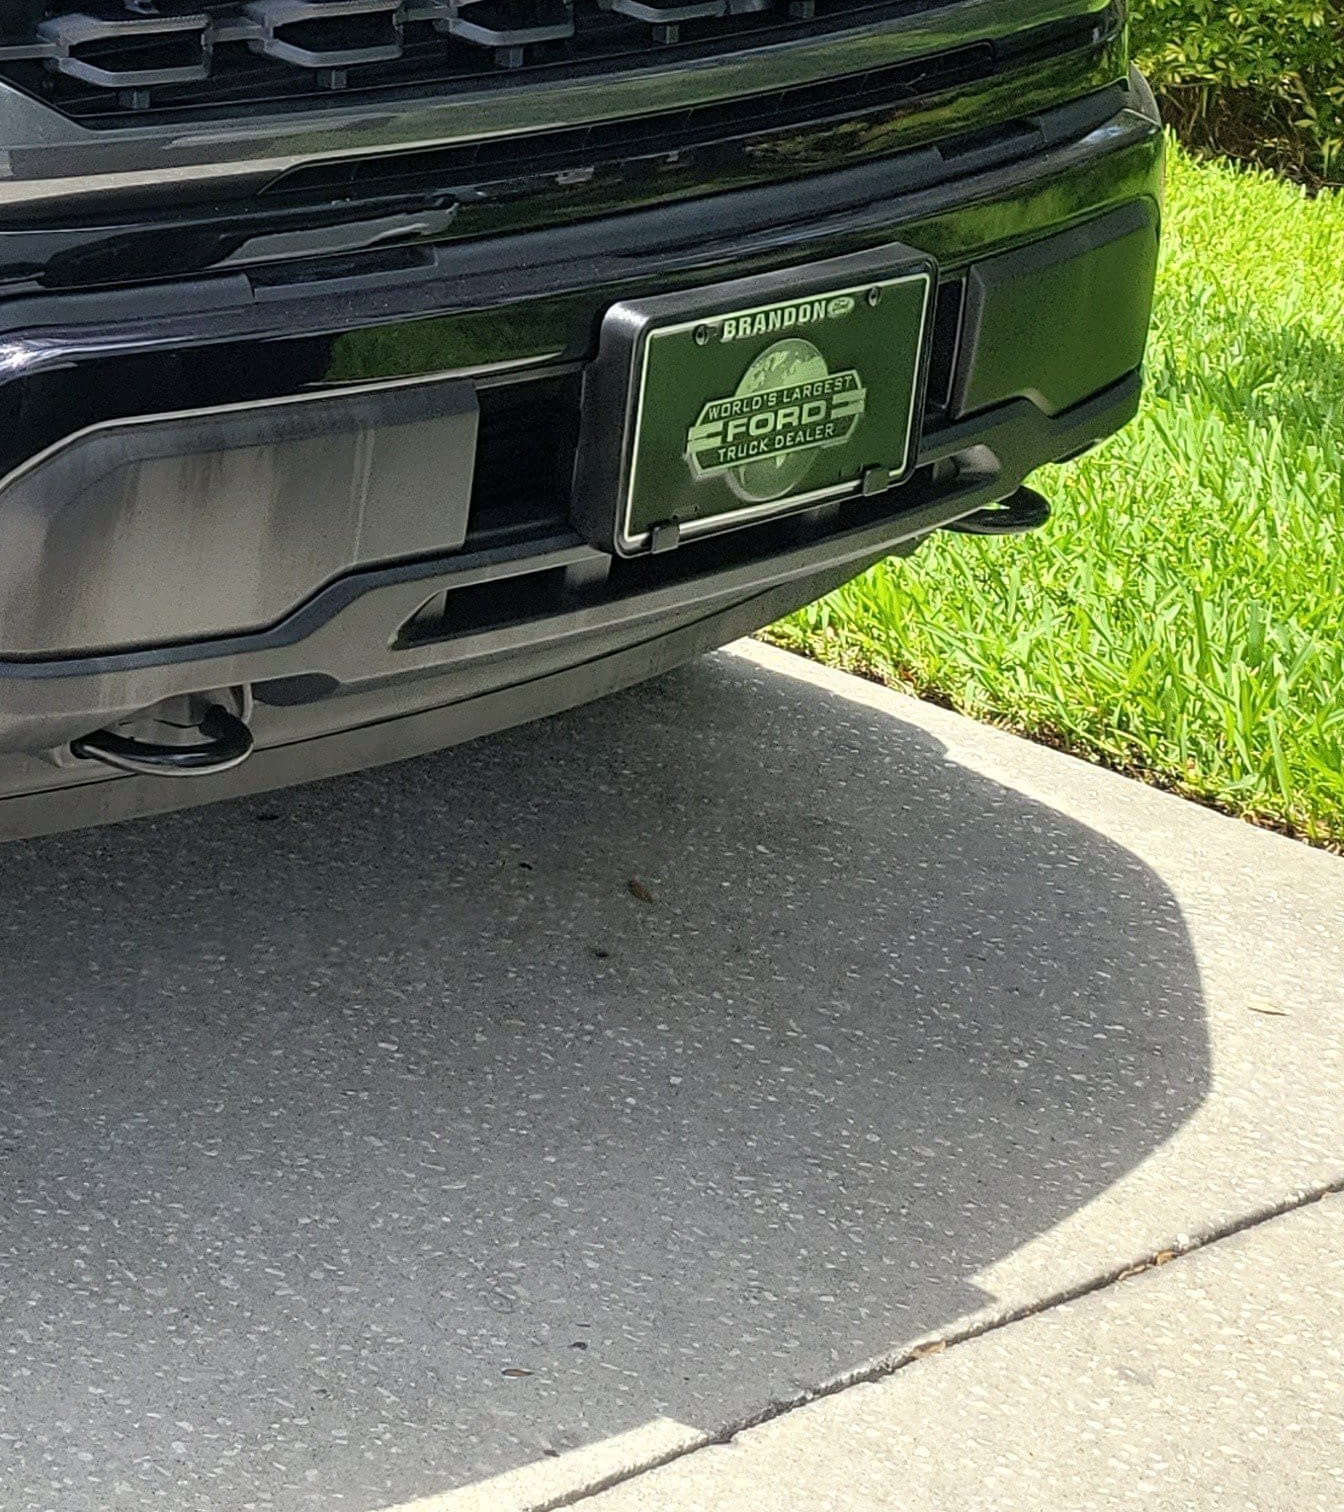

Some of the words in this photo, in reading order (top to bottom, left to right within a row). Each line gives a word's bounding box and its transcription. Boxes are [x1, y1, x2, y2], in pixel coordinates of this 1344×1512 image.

[721, 300, 828, 342] BRANDON
[708, 392, 777, 420] WORLD'S
[783, 375, 853, 403] LARGEST
[726, 399, 828, 442] FORD
[717, 439, 769, 462] TRUCK
[775, 423, 835, 449] DEALER
